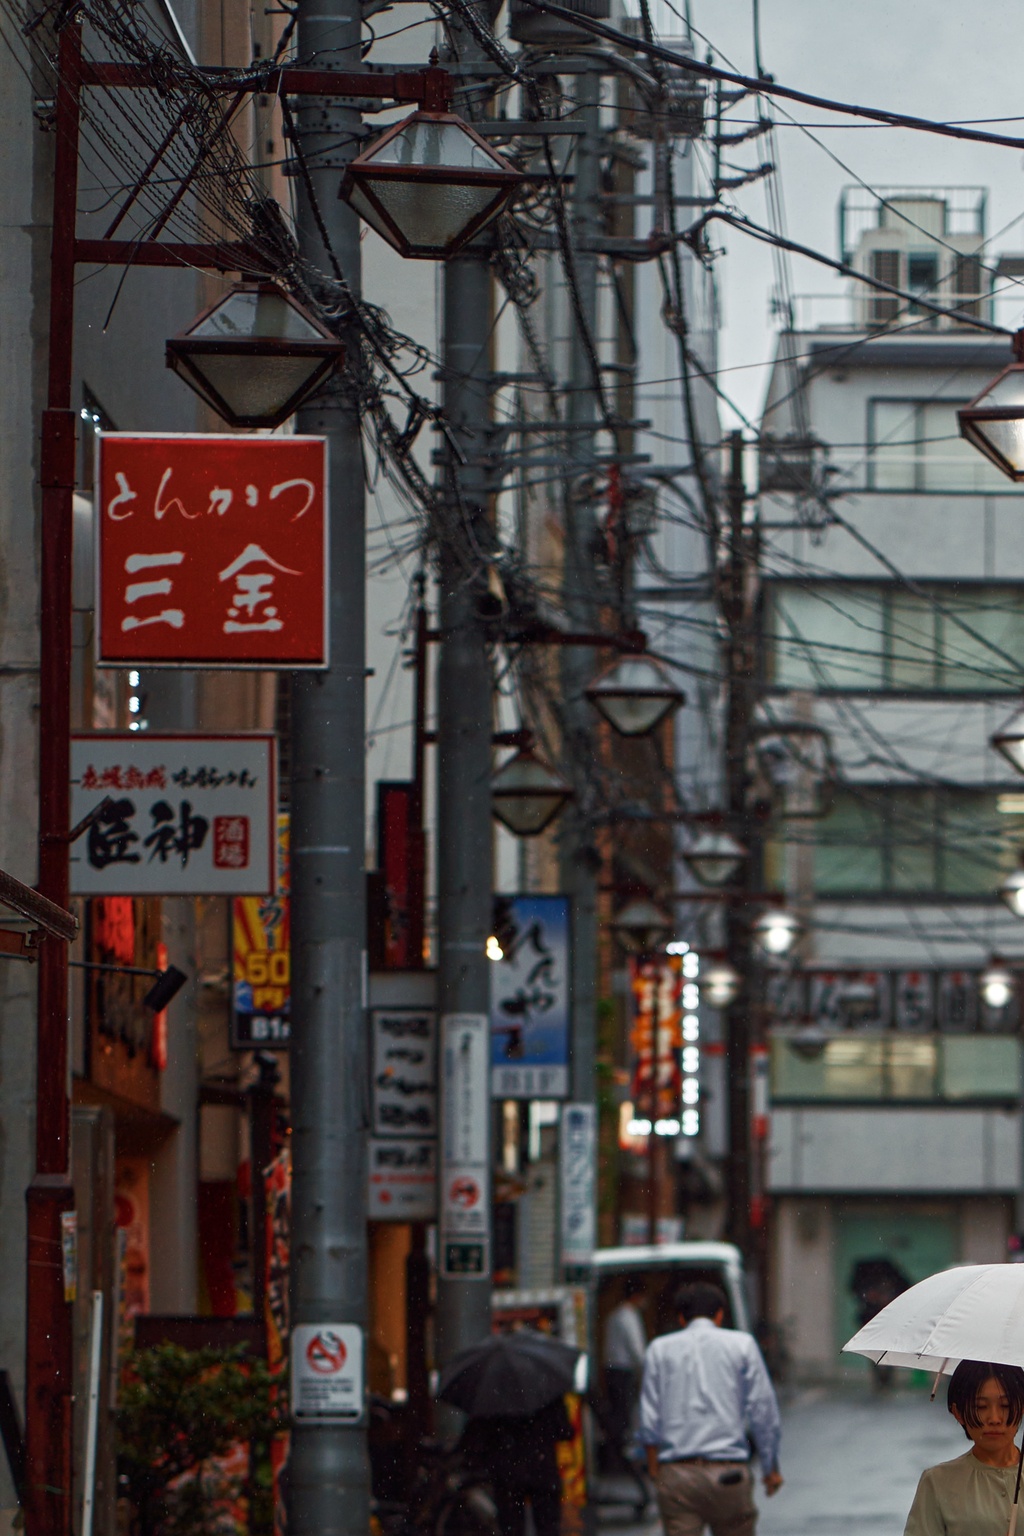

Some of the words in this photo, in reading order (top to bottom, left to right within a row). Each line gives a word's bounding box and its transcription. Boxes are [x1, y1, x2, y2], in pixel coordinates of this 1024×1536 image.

[108, 467, 316, 522] とんかつ
[121, 543, 303, 634] 三金
